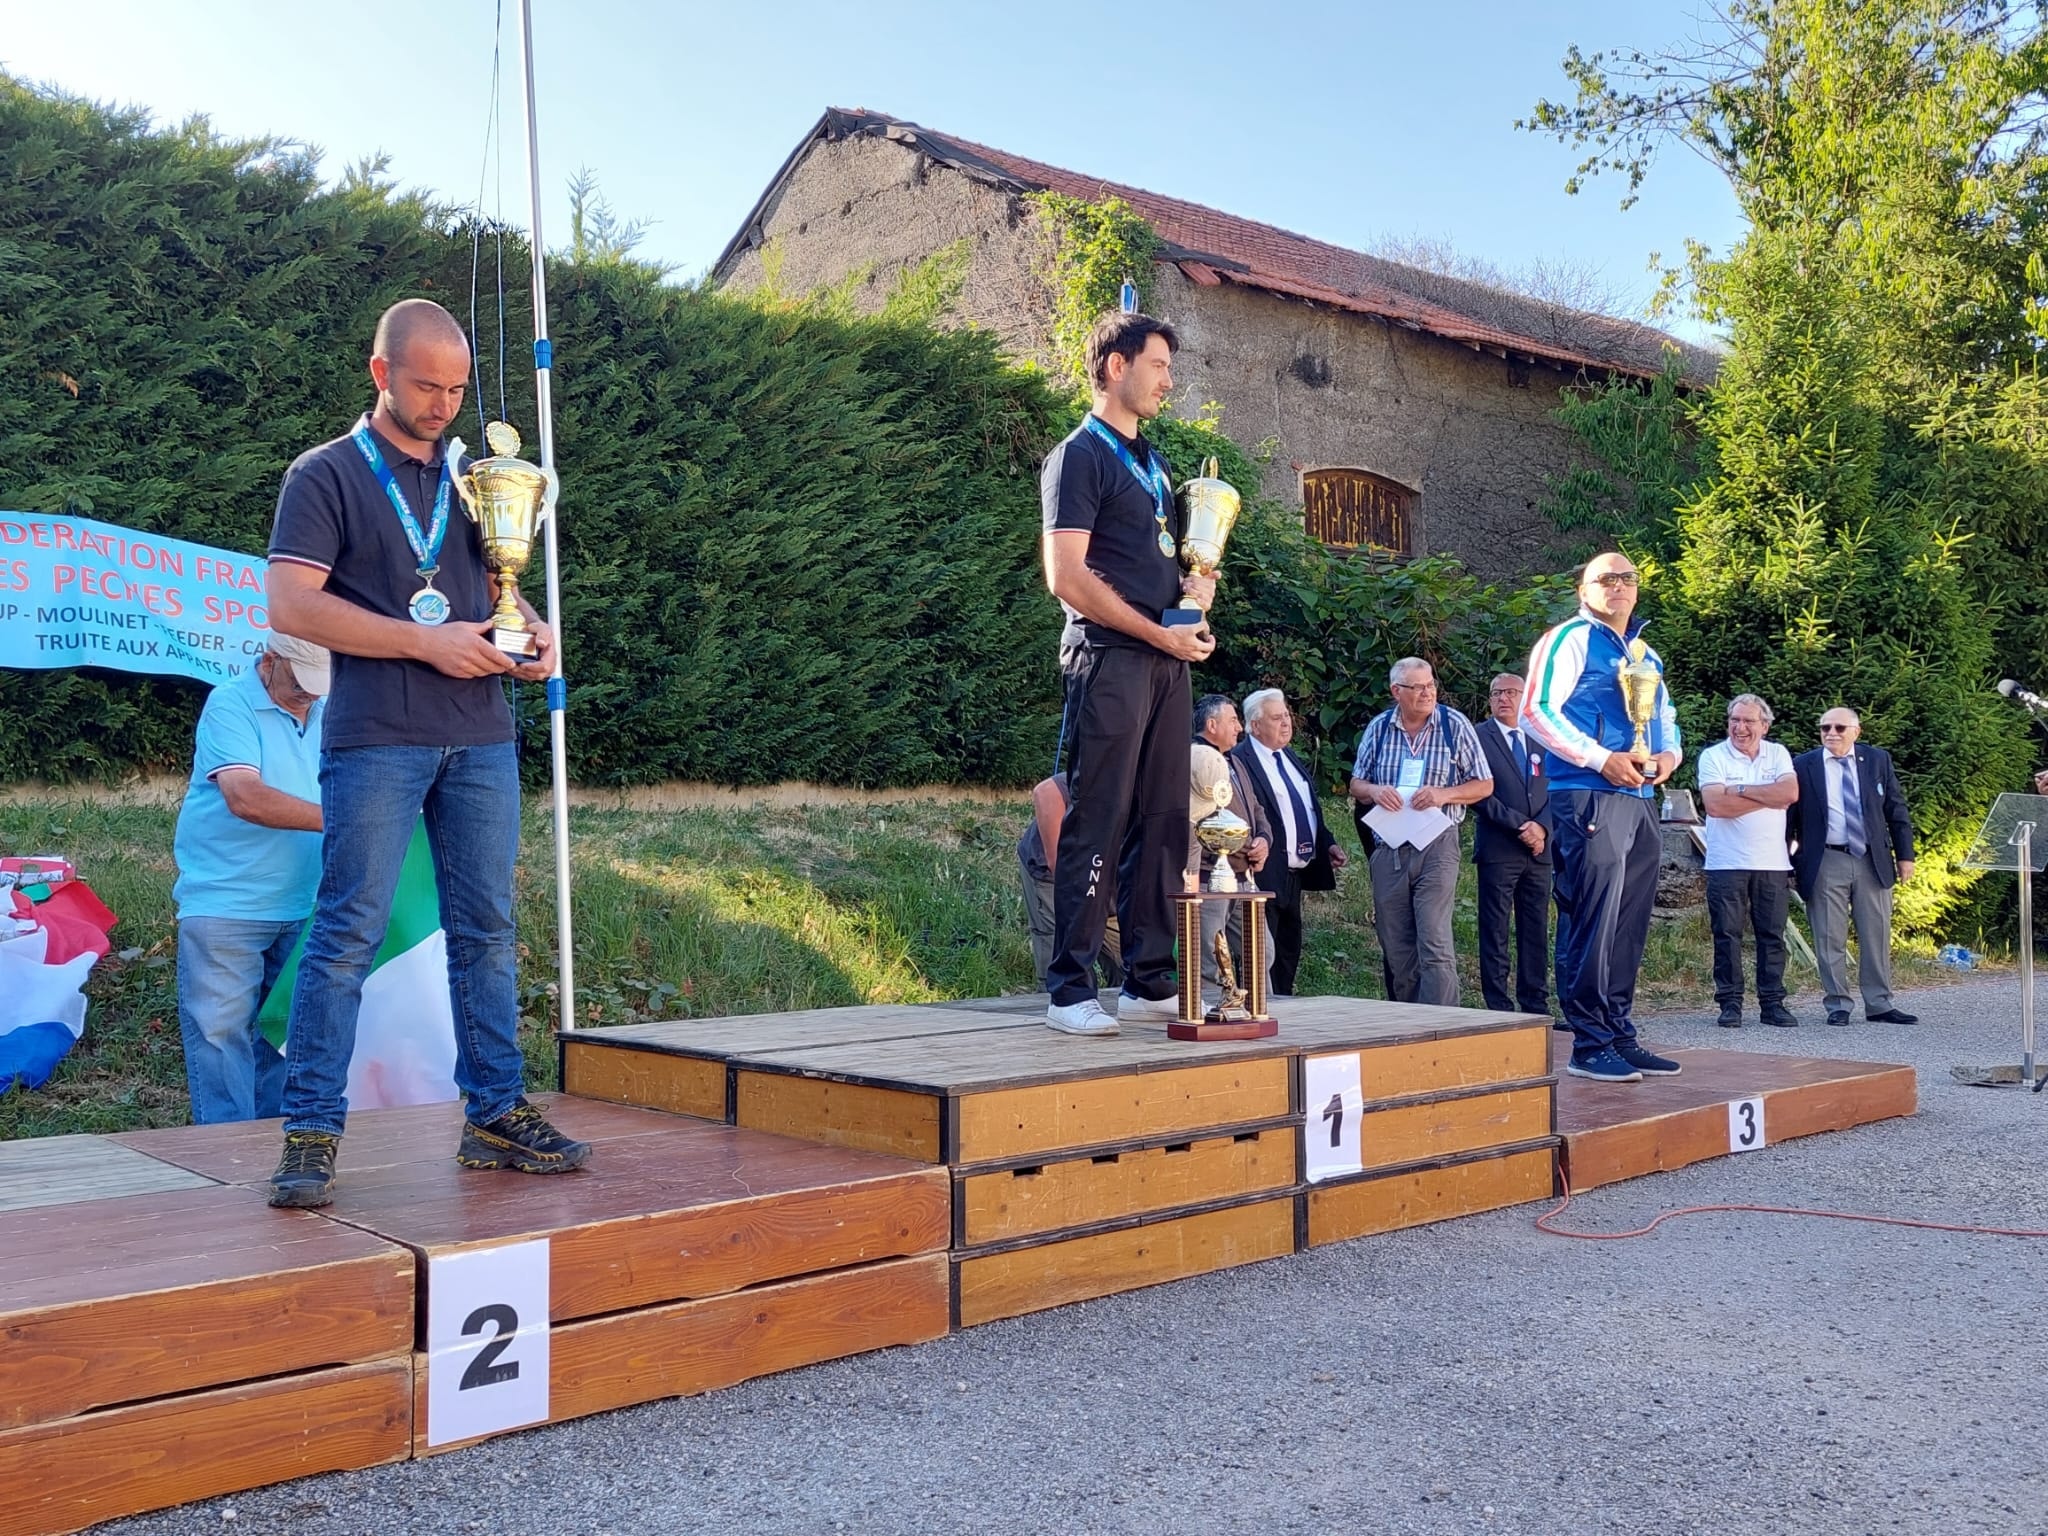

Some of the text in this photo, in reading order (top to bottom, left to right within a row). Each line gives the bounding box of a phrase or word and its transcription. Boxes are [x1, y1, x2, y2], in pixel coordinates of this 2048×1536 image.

[0, 522, 184, 577] DERATION
[53, 565, 184, 616] PECHES
[203, 595, 271, 629] SPO
[35, 632, 112, 651] TRUITE
[116, 638, 159, 658] AUX
[37, 606, 149, 630] MOULINET
[242, 639, 265, 656] CA
[1086, 854, 1103, 898] GNA
[1322, 1093, 1343, 1148] 1
[1739, 1102, 1756, 1146] 3
[458, 1303, 520, 1392] 2
